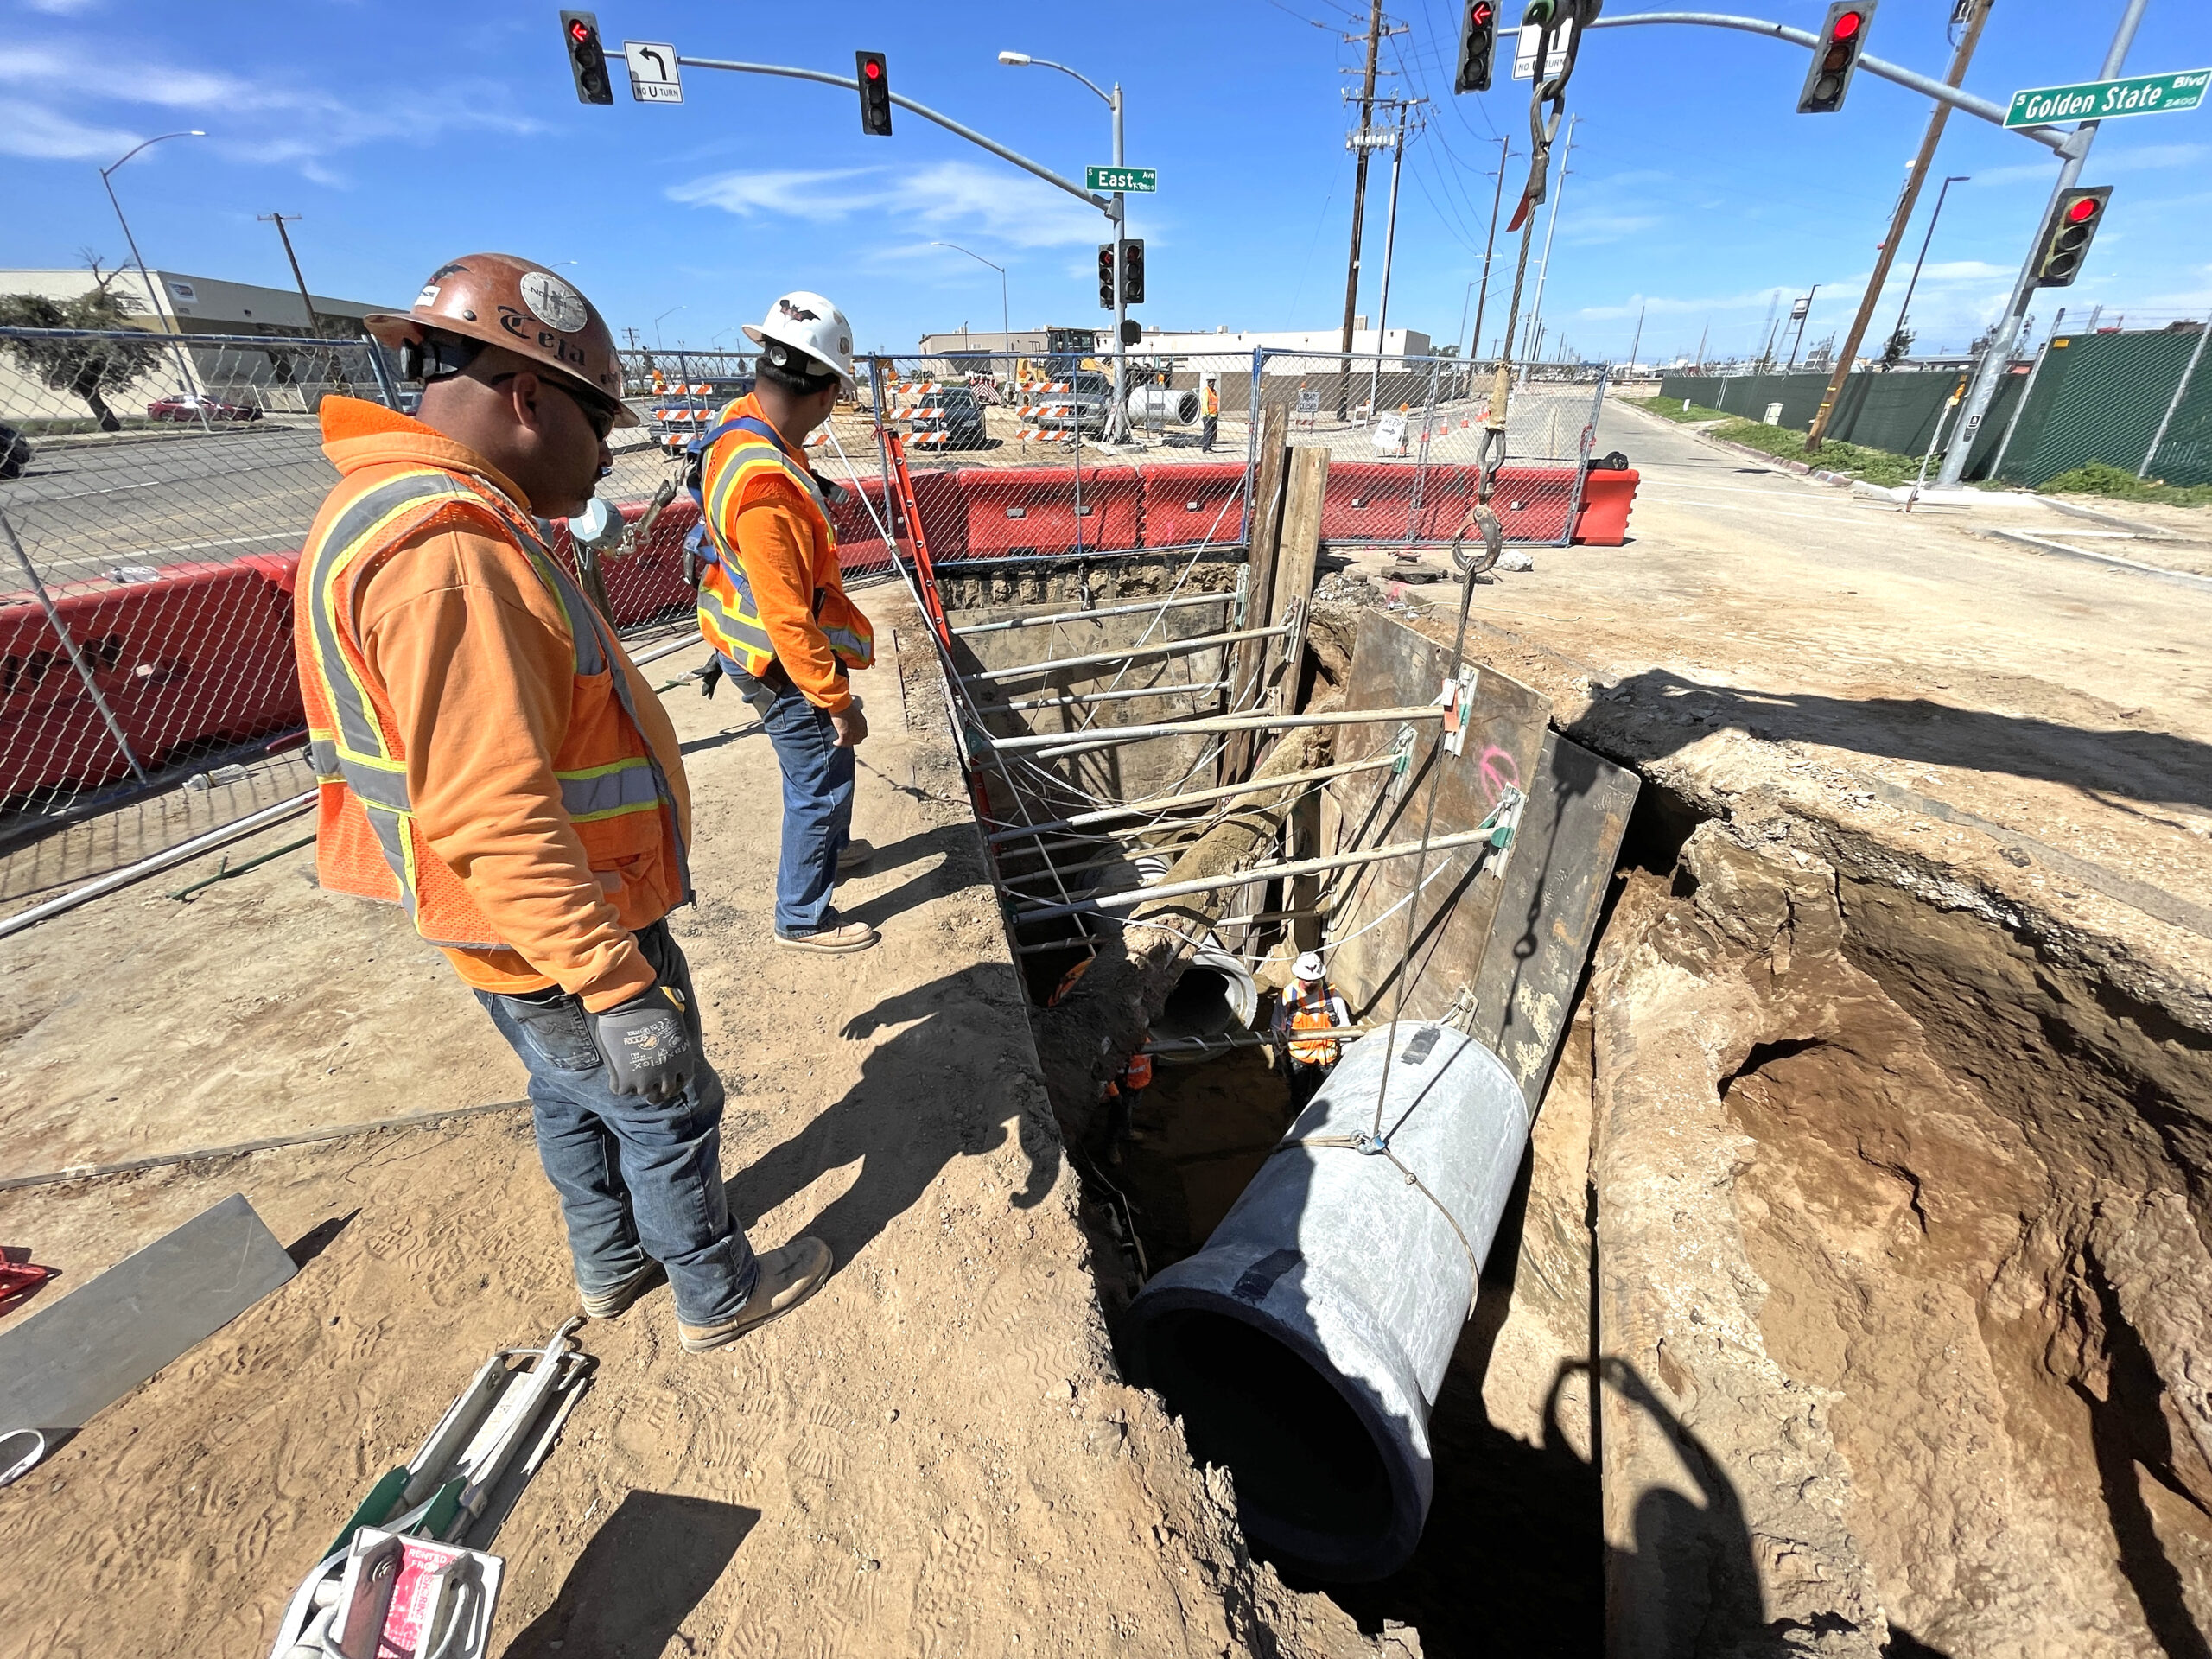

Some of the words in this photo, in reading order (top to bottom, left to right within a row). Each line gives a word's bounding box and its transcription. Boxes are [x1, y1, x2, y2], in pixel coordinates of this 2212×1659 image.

[1518, 62, 1529, 72] NO
[636, 87, 647, 96] NO
[648, 86, 658, 98] U
[659, 88, 679, 99] TURN
[2016, 94, 2027, 106] S
[2025, 92, 2096, 120] Golden
[2101, 83, 2163, 111] State
[2171, 73, 2208, 89] Blvd
[2163, 96, 2197, 108] 2400
[1098, 171, 1134, 188] East
[409, 1548, 448, 1564] RENTED
